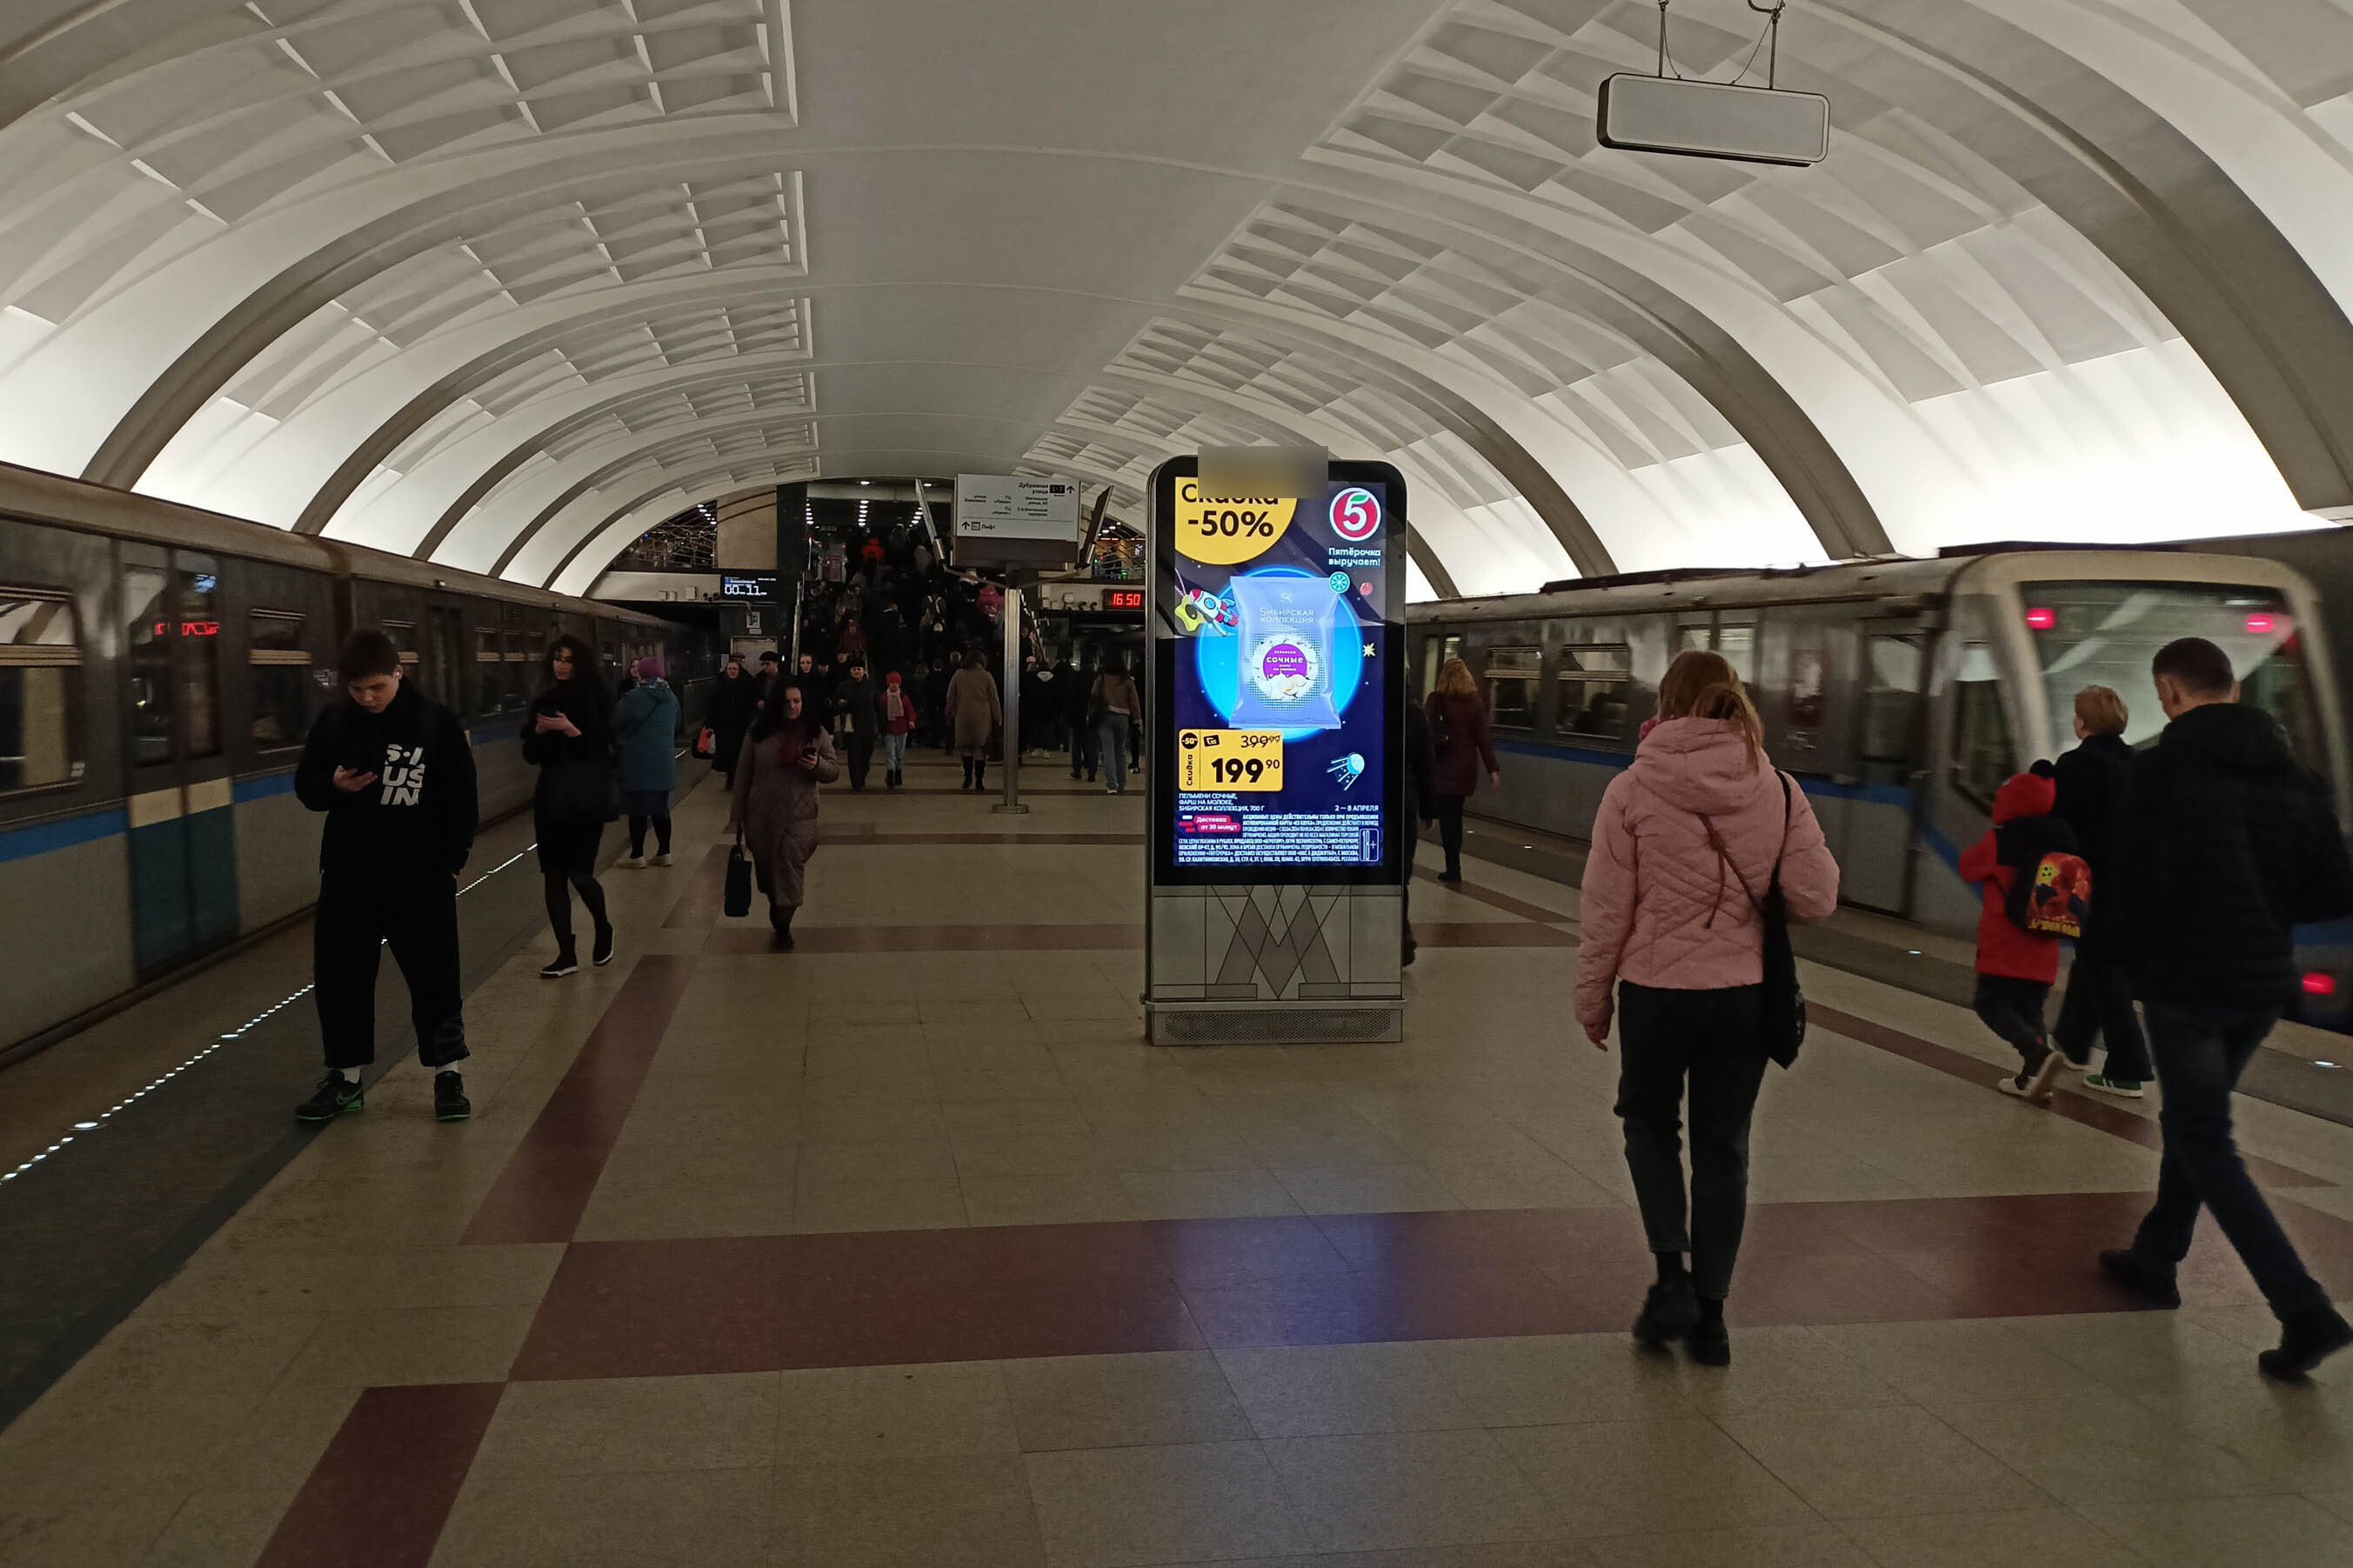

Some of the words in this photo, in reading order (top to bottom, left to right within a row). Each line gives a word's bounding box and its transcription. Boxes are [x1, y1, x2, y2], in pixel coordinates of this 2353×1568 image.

[1188, 510, 1274, 537] -50%
[1328, 547, 1381, 557] Пятёрочка
[1328, 557, 1381, 567] выручает!
